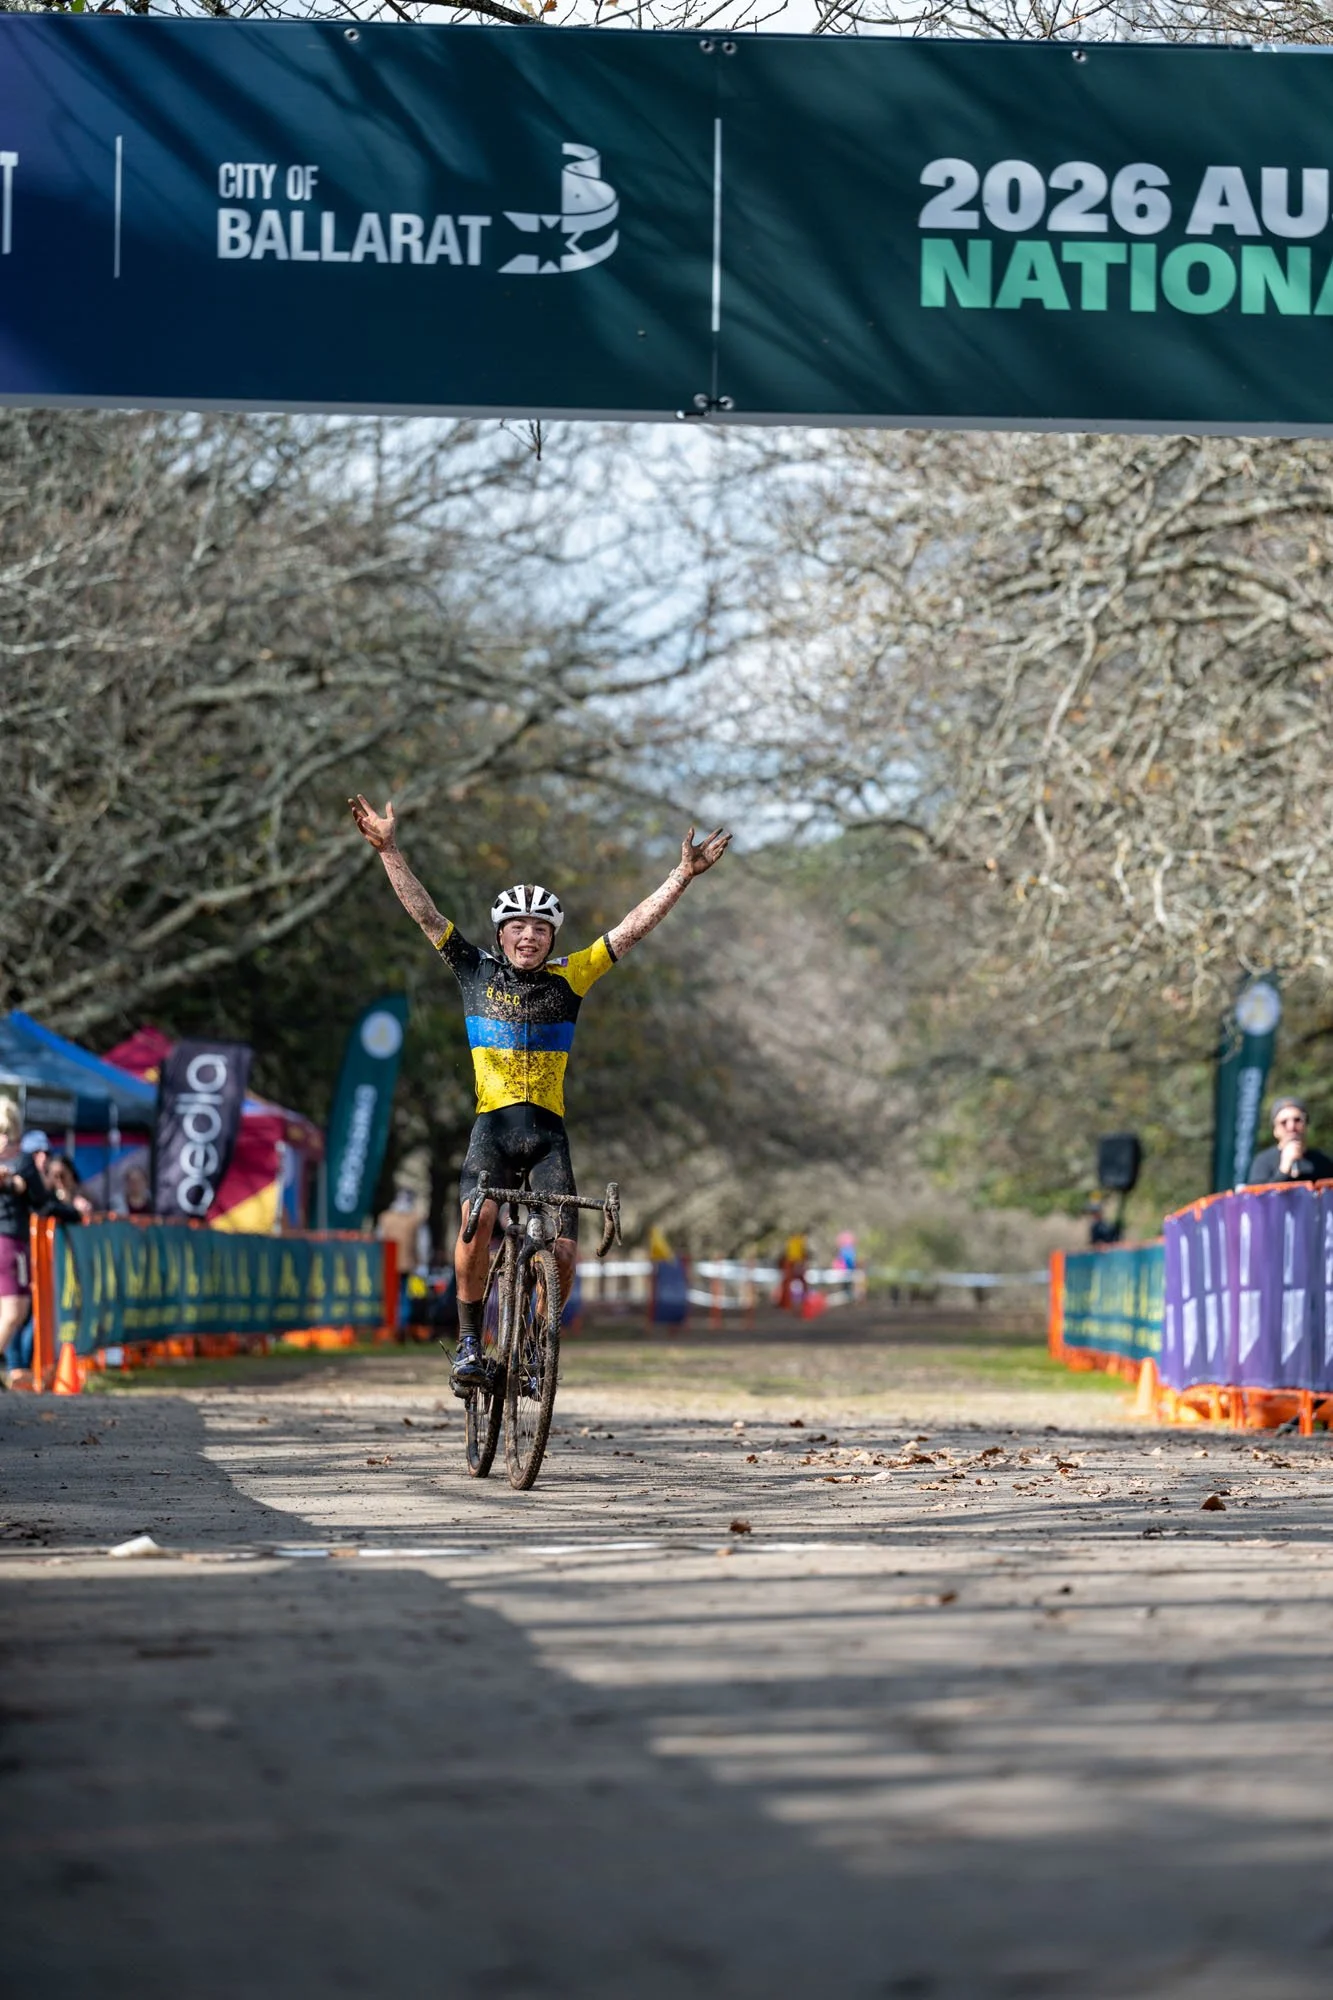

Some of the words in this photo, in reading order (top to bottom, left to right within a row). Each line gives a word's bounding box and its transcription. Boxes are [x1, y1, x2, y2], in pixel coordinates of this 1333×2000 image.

[218, 162, 277, 200] CITY
[286, 165, 319, 201] OF
[918, 157, 1172, 235] 2026
[1185, 165, 1333, 239] AU
[217, 207, 491, 266] BALLARAT
[920, 238, 1333, 316] NATION
